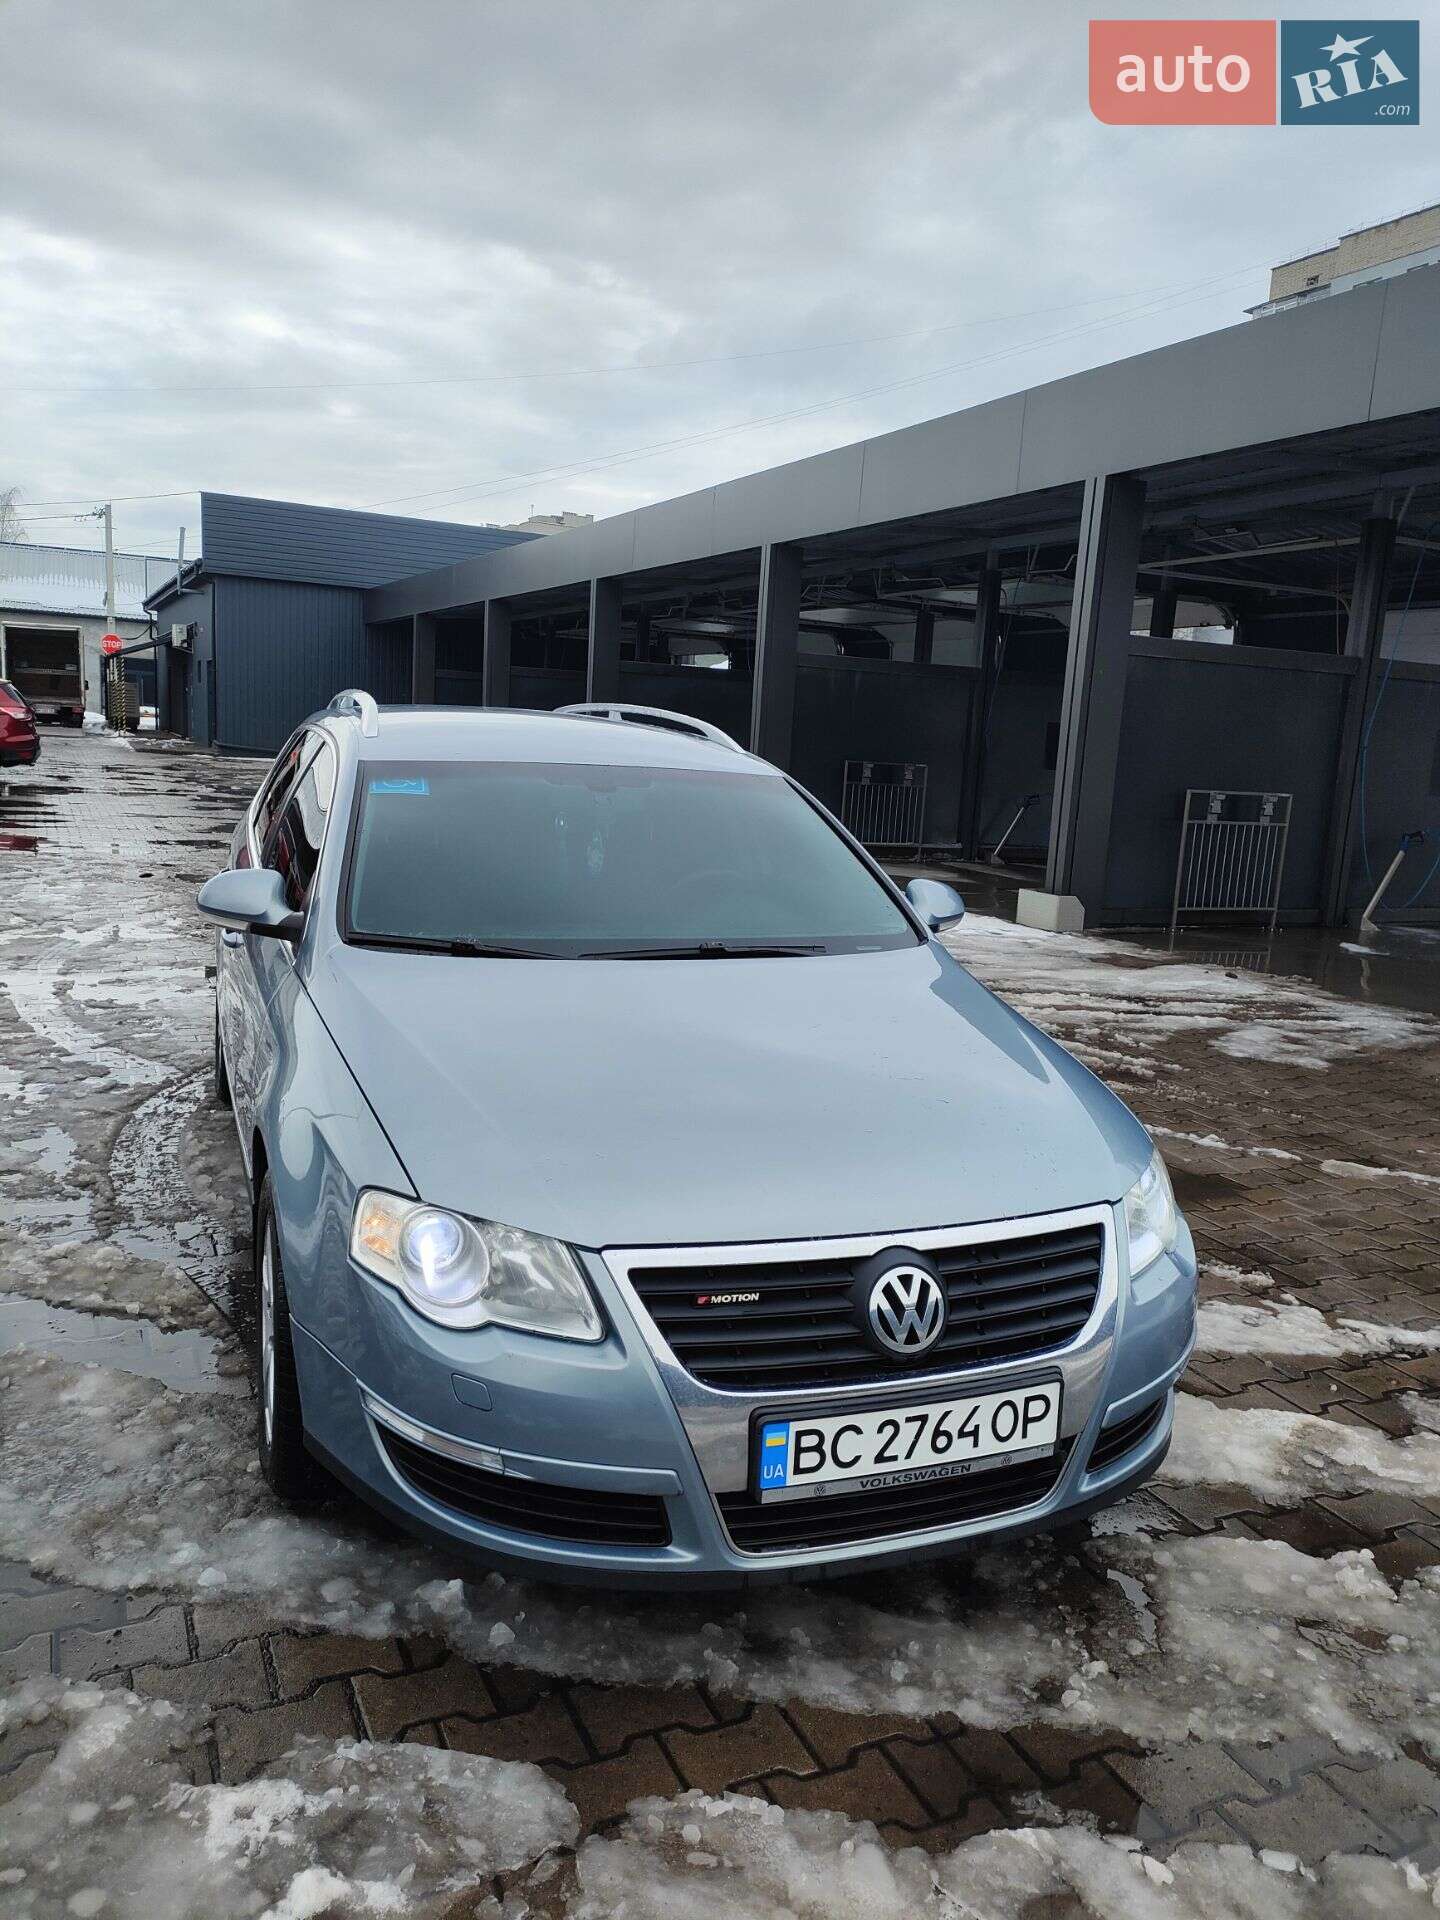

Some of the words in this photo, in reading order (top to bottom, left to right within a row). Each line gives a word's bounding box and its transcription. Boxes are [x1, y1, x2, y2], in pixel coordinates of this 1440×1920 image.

[102, 640, 121, 648] STOP
[792, 1423, 864, 1476] BC
[873, 1405, 981, 1464] 2764
[991, 1393, 1051, 1443] OP
[763, 1464, 784, 1479] UA
[860, 1464, 971, 1488] VOLKSWAGEN
